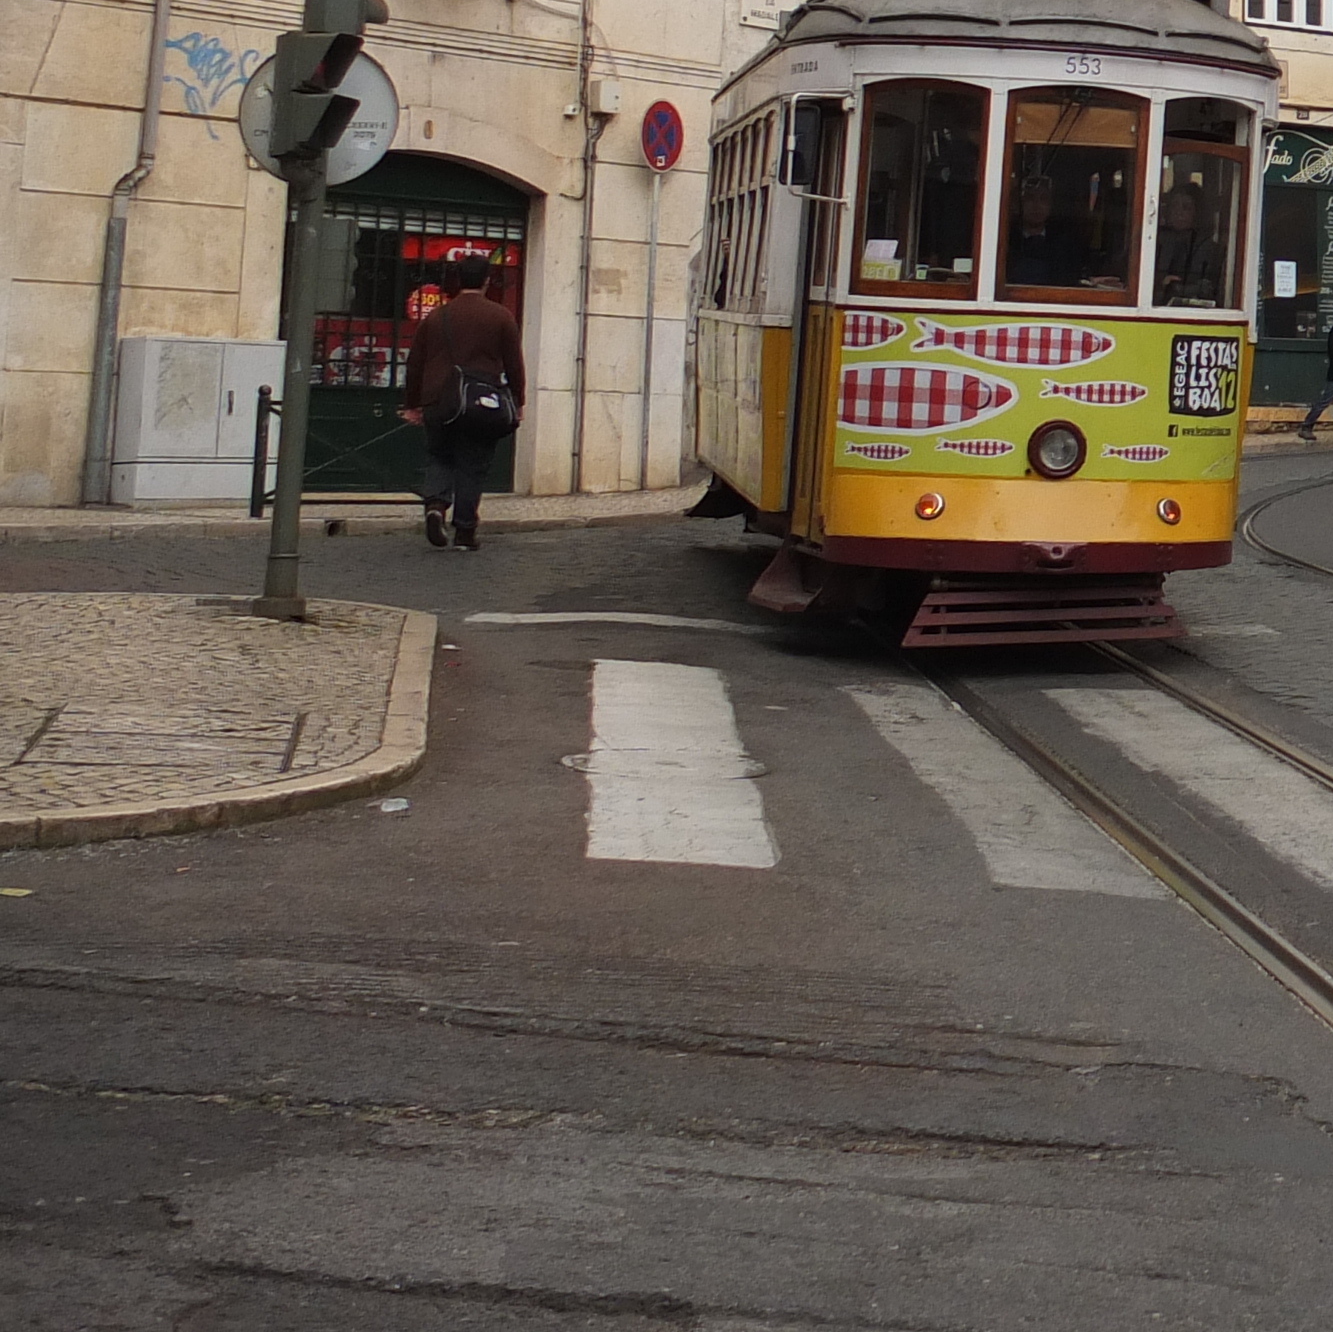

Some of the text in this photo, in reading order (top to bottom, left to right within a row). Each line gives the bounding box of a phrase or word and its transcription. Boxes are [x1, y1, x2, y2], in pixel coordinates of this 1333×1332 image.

[1065, 56, 1101, 75] 553
[1190, 340, 1238, 367] FESTAS
[1173, 341, 1188, 396] EGEAC
[1188, 388, 1221, 411] BOA
